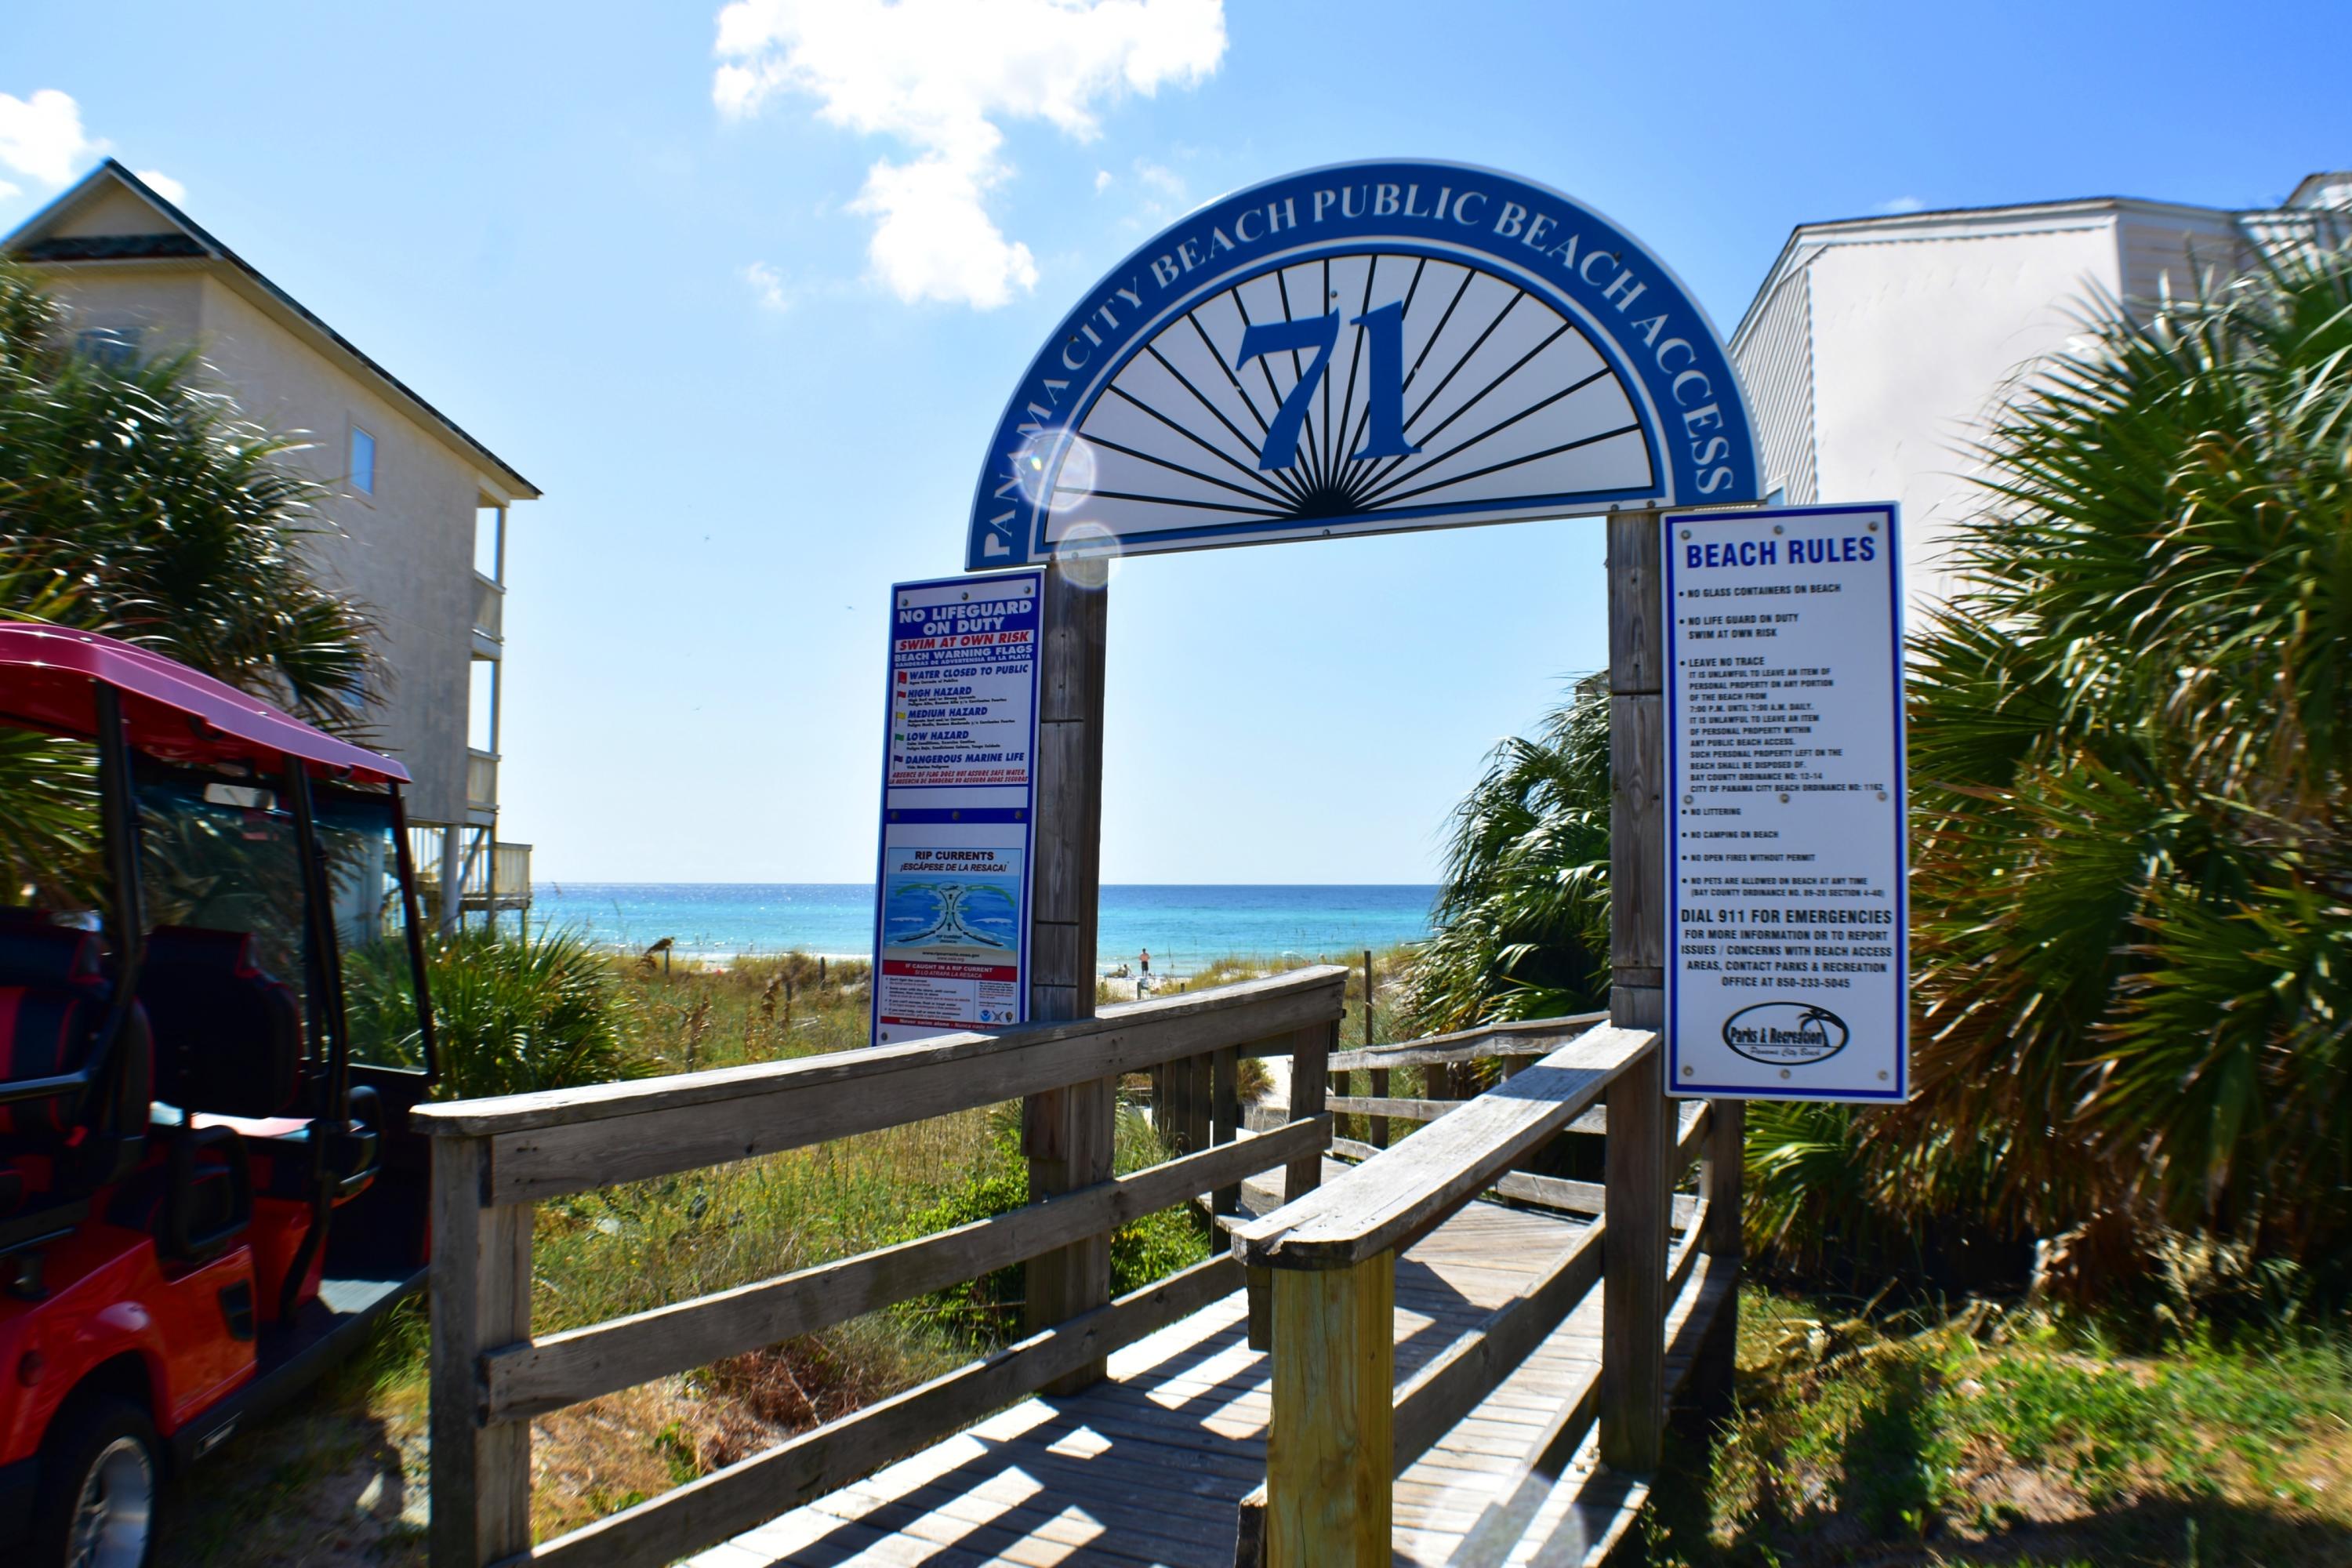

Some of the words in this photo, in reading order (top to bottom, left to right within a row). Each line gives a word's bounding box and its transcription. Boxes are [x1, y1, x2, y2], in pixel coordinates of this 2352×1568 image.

[984, 379, 1070, 557] PANAMA
[1062, 276, 1142, 371] CITY
[1150, 198, 1297, 289] BEACH
[1313, 184, 1488, 226] PUBLIC
[1494, 201, 1646, 313] BEACH
[1631, 314, 1733, 494] ACCESS
[1236, 300, 1421, 470] 71
[1686, 540, 1776, 569] BEACH
[1788, 535, 1875, 564] RULES
[1687, 589, 1700, 598] NO
[1702, 587, 1731, 597] GLASS
[1733, 585, 1791, 597] CONTAINERS
[1793, 584, 1807, 593] ON
[1809, 583, 1841, 593] BEACH
[898, 608, 925, 623] NO
[932, 600, 1032, 620] LIFEGUARD
[1687, 616, 1700, 626] NO
[1703, 615, 1722, 625] LIFE
[1725, 614, 1757, 624] GUARD
[1759, 613, 1772, 623] ON
[1774, 612, 1798, 622] DUTY
[923, 621, 949, 636] ON
[957, 617, 1004, 633] DUTY
[1688, 630, 1715, 640] SWIM
[1716, 629, 1729, 638] AT
[1730, 628, 1753, 638] OWN
[1755, 627, 1777, 637] RISK
[899, 637, 936, 651] SWIM
[940, 637, 956, 648] AT
[960, 633, 993, 646] OWN
[998, 630, 1029, 643] RISK
[894, 652, 929, 662] BEACH
[933, 648, 991, 659] WARNING
[995, 644, 1033, 655] FLAGS
[1688, 658, 1717, 667] LEAVE
[1719, 657, 1733, 666] NO
[1734, 656, 1765, 666] TRACE
[909, 670, 940, 680] WATER
[943, 667, 977, 678] CLOSED
[980, 666, 992, 676] TO
[995, 663, 1029, 675] PUBLIC
[1708, 670, 1748, 678] UNLAWFUL
[1749, 669, 1760, 677] TO
[1761, 668, 1785, 677] LEAVE
[1799, 667, 1819, 676] ITEM
[1689, 681, 1728, 690] PERSONAL
[1729, 681, 1769, 689] PROPERTY
[1800, 678, 1834, 687] PORTION
[907, 688, 931, 698] HIGH
[933, 686, 972, 696] HAZARD
[1689, 693, 1700, 702] OF
[1717, 692, 1743, 701] BEACH
[1744, 691, 1767, 700] FROM
[907, 709, 945, 718] MEDIUM
[949, 706, 988, 717] HAZARD
[906, 731, 927, 741] LOW
[930, 730, 968, 740] HAZARD
[1701, 727, 1740, 735] PERSONAL
[1742, 726, 1782, 735] PROPERTY
[1783, 725, 1811, 734] WITHIN
[1706, 739, 1735, 747] PUBLIC
[1736, 738, 1762, 746] BEACH
[905, 753, 962, 764] DANGEROUS
[964, 753, 1001, 762] MARINE
[1005, 752, 1024, 761] LIFE
[914, 851, 932, 860] RIP
[935, 851, 994, 860] CURRENTS
[958, 863, 968, 872] LA
[1681, 909, 1714, 923] DIAL
[1718, 909, 1744, 923] 911
[1751, 909, 1780, 923] FOR
[1785, 909, 1892, 924] EMERGENCIES
[1684, 929, 1704, 939] FOR
[1707, 929, 1737, 939] MORE
[1740, 929, 1810, 940] INFORMATION
[1813, 930, 1828, 940] OR
[1831, 930, 1844, 940] TO
[1847, 931, 1888, 941] REPORT
[1681, 945, 1716, 955] ISSUES
[1726, 945, 1781, 956] CONCERNS
[1784, 946, 1811, 956] WITH
[1813, 946, 1849, 956] BEACH
[1852, 946, 1893, 956] ACCESS
[1686, 960, 1722, 971] AREAS,
[1725, 960, 1772, 971] CONTACT
[1774, 961, 1808, 971] PARKS
[1810, 961, 1819, 971] &
[1822, 961, 1886, 973] RECREATION
[1721, 976, 1758, 986] OFFICE
[1760, 977, 1774, 987] AT
[1776, 977, 1850, 988] 850-233-5045
[1731, 1026, 1758, 1043] Parks
[1760, 1027, 1766, 1043] &
[1769, 1027, 1823, 1045] Recreation
[1749, 1046, 1779, 1055] Panama
[1780, 1047, 1797, 1057] City
[1799, 1047, 1820, 1056] Beach
